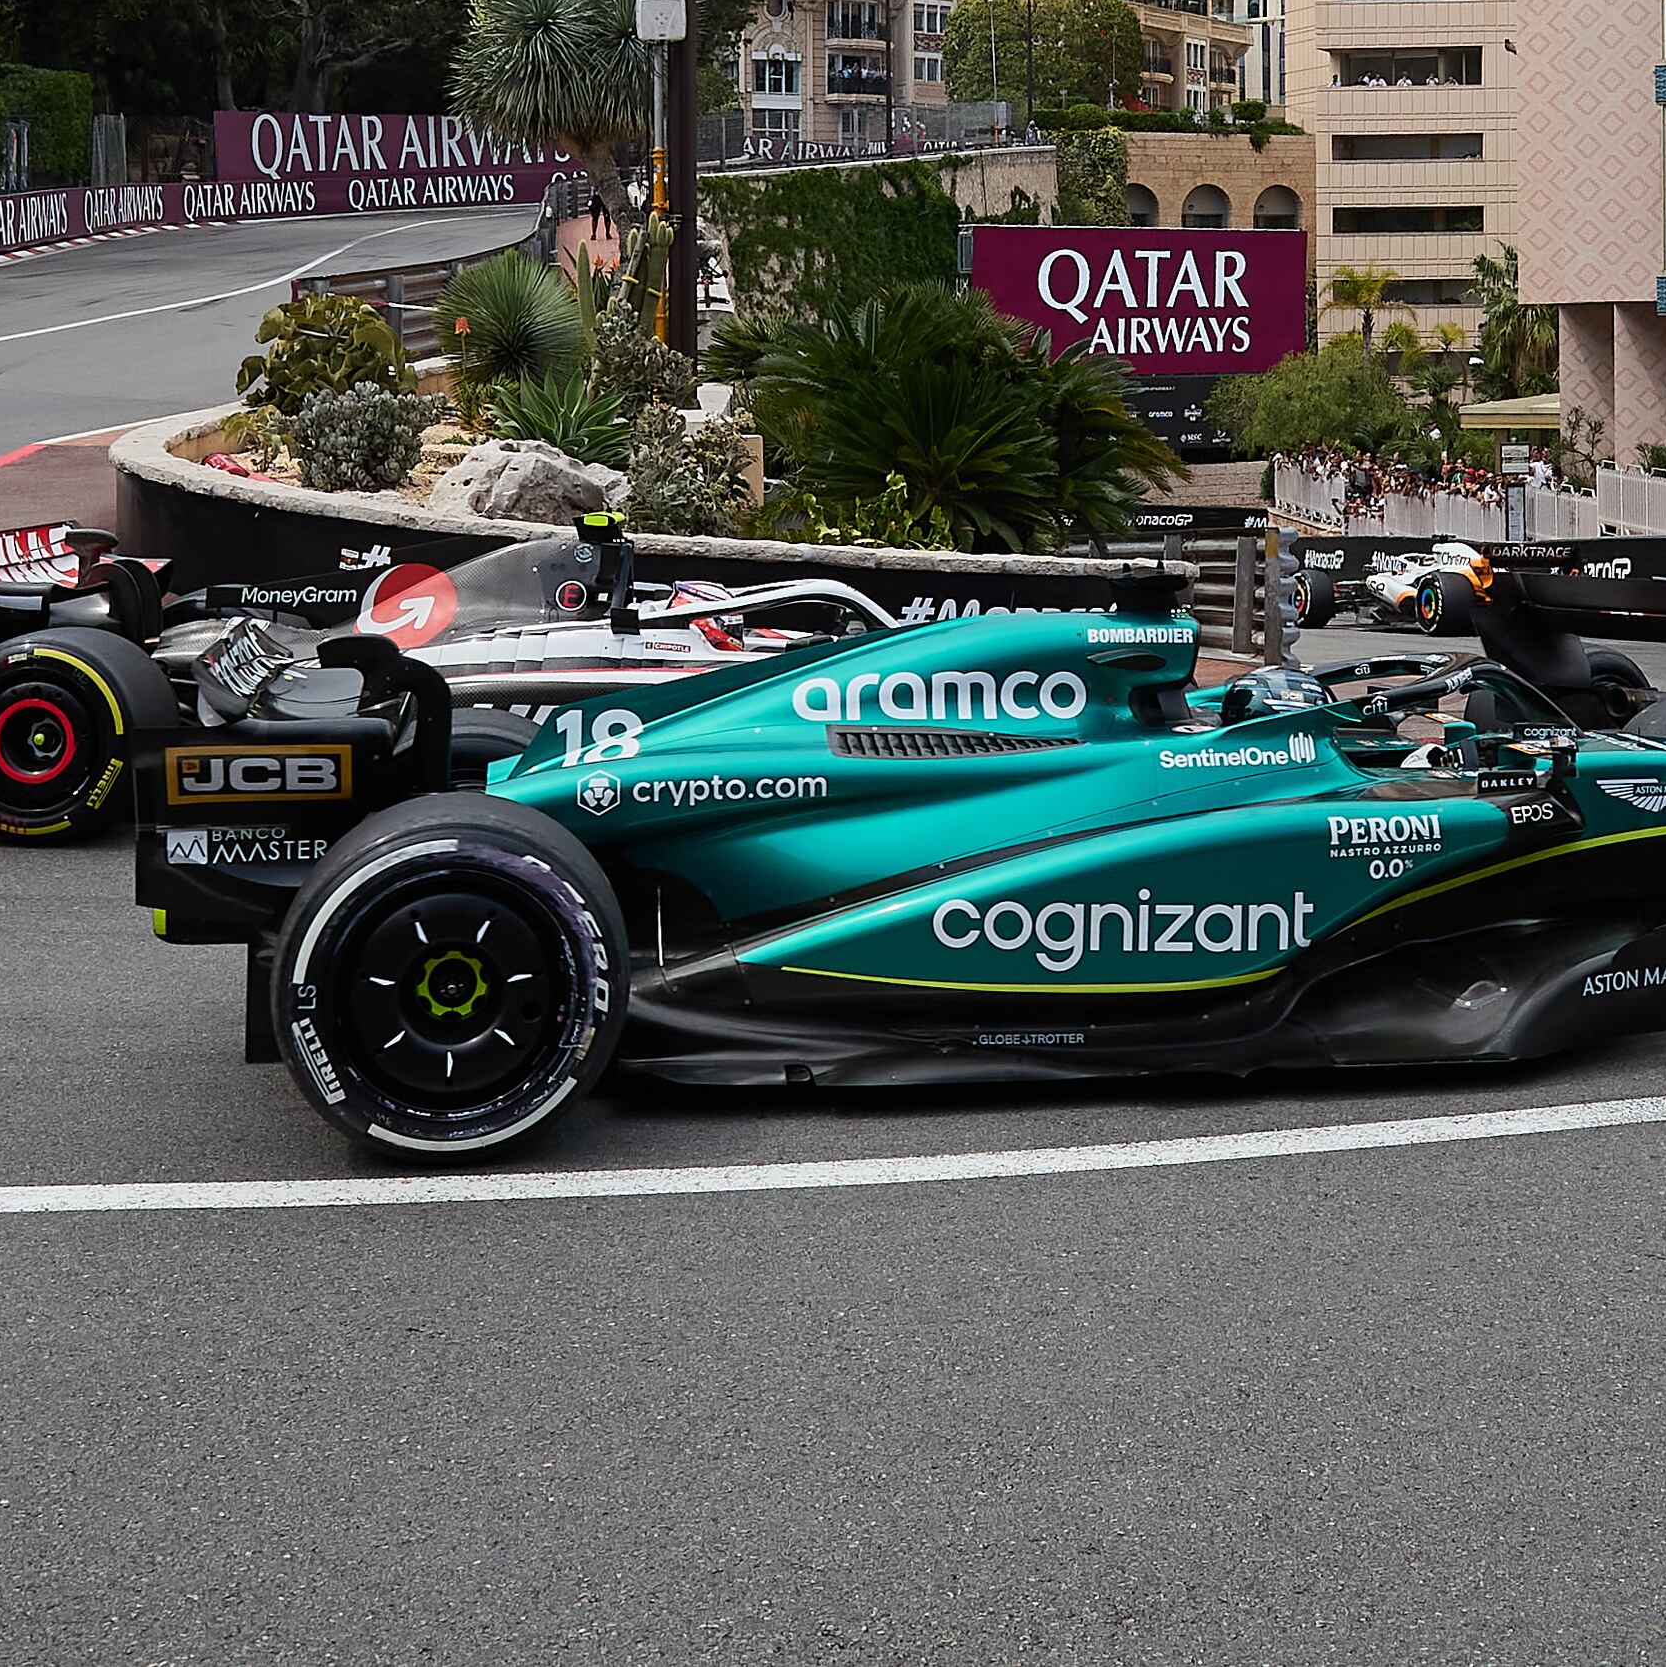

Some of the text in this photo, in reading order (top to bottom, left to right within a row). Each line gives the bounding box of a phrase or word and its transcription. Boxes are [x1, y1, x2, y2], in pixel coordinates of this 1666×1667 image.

[251, 113, 571, 180] QATAR AIRW
[183, 181, 315, 221] QATAR AIRWAYS
[348, 175, 514, 211] QATAR AIRWAYS
[18, 192, 68, 243] AIRWAYS
[84, 185, 164, 233] QATAR AIRWAYS
[1037, 248, 1250, 323] QATAR
[1089, 316, 1251, 354] AIRWAYS
[1491, 547, 1572, 559] DARKTRACE
[241, 587, 357, 607] MoneyGram
[653, 644, 691, 653] CHIPOTLE
[1086, 627, 1194, 645] BOMBARDIER
[1354, 664, 1371, 676] citi
[792, 671, 1088, 722] aramco
[1362, 695, 1388, 716] citi
[555, 709, 643, 767] 18
[1524, 726, 1578, 740] cognizant
[1160, 746, 1290, 770] SentinelOne
[86, 756, 124, 810] PIRELLI
[182, 757, 338, 795] JCB
[633, 774, 828, 807] crypto.com
[1481, 777, 1534, 789] OAKLEY
[1635, 784, 1662, 795] ASTON
[1510, 802, 1554, 825] EPOS
[212, 827, 286, 840] BANCO
[1327, 814, 1442, 845] PERONI
[211, 840, 328, 865] MASTER
[1330, 843, 1442, 858] NASTRO AZZURRO
[1369, 858, 1414, 880] 0.0%
[933, 887, 1315, 972] cognizant
[1582, 968, 1640, 997] ASTON
[292, 1016, 347, 1106] PIRELLI
